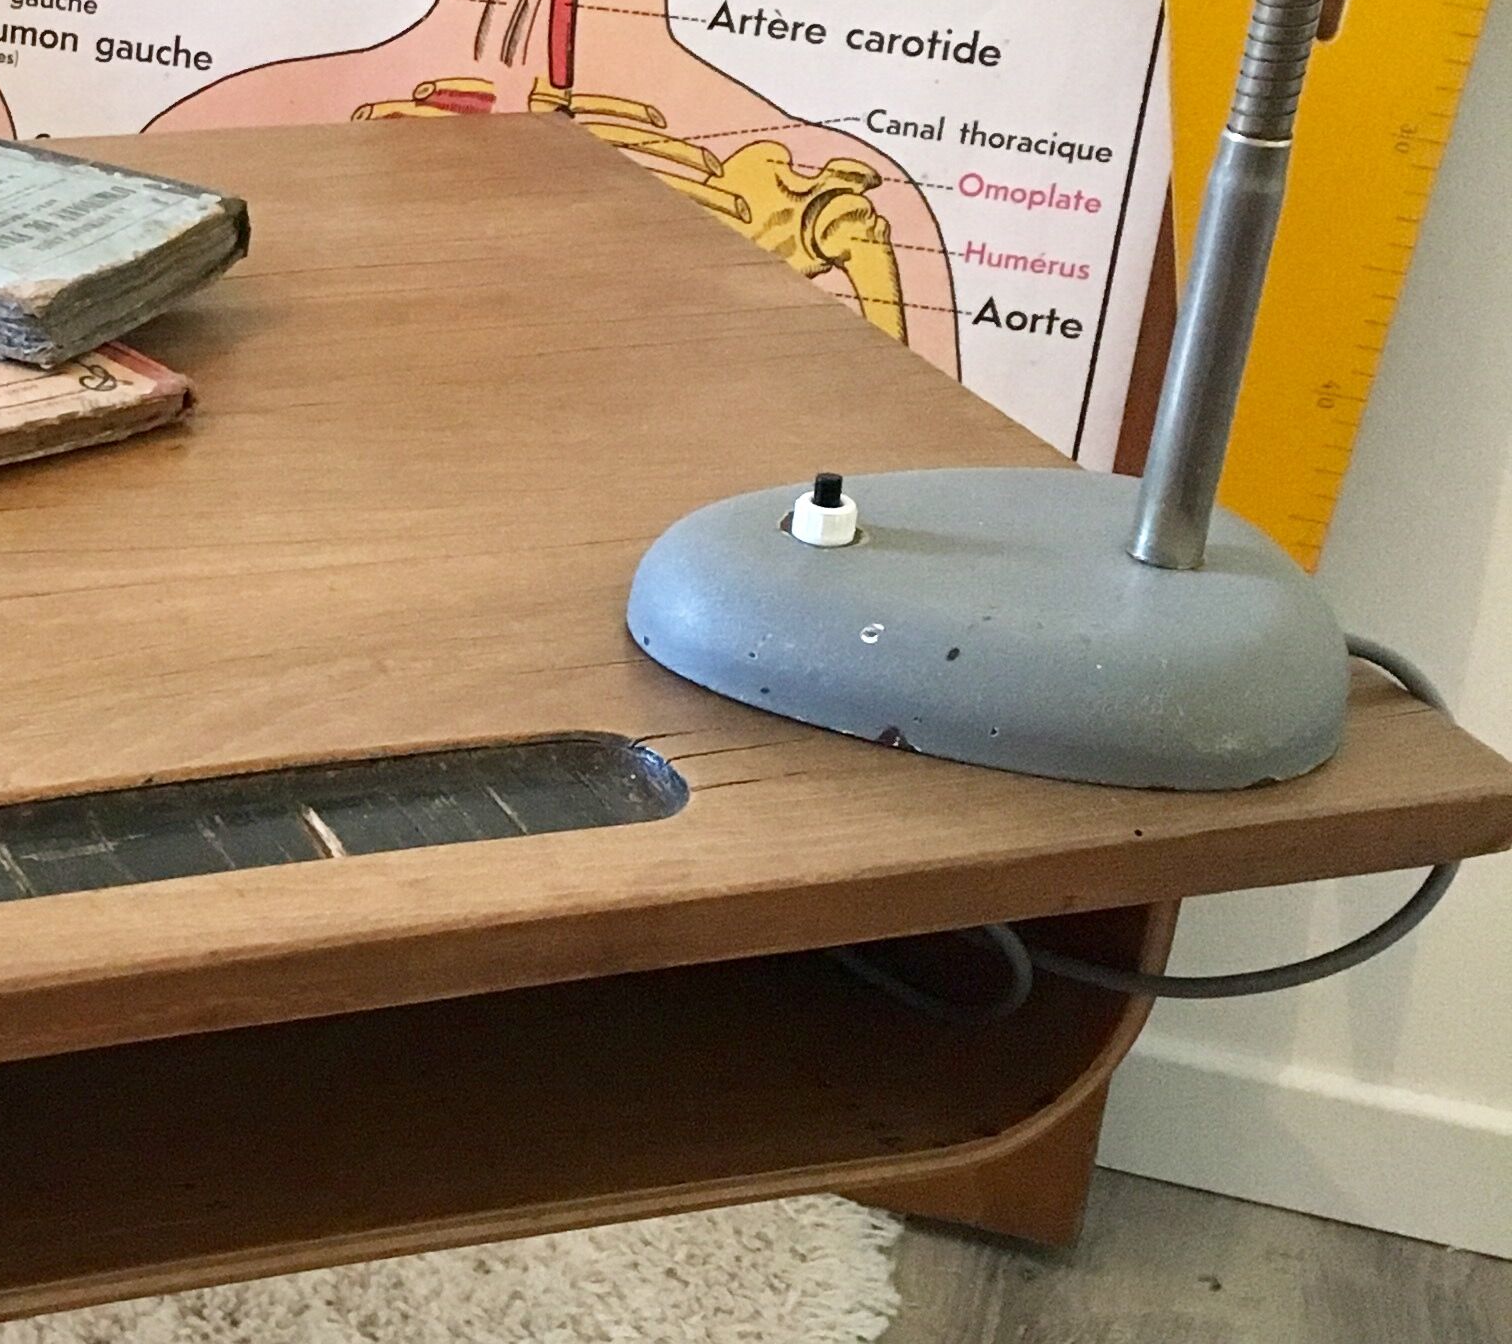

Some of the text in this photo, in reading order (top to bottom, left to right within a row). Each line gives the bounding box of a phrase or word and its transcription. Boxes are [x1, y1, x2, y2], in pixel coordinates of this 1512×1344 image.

[94, 34, 214, 71] gauche
[707, 0, 1003, 69] Artère carotide
[865, 108, 1114, 164] Canal thoracique
[957, 172, 1102, 215] Omoplate
[964, 241, 1091, 281] Humérus
[972, 295, 1084, 340] Aorte
